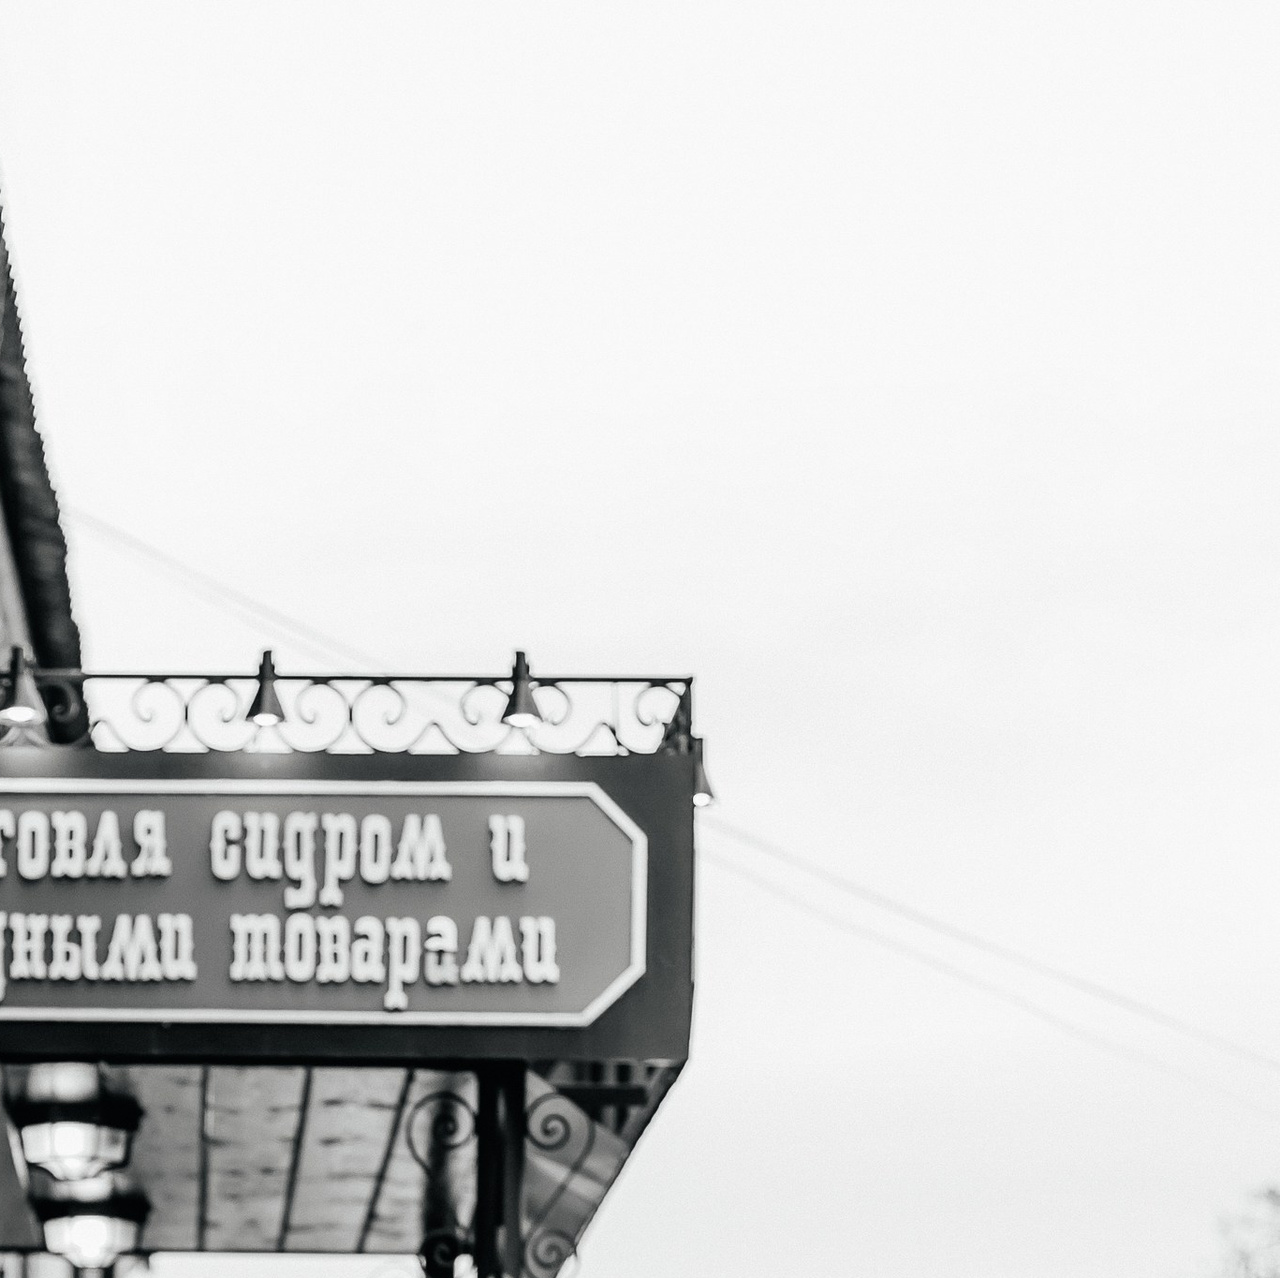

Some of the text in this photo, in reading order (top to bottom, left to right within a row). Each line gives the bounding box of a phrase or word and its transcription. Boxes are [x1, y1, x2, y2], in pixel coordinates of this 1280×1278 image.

[210, 809, 453, 908] сидром
[488, 809, 530, 882] и
[229, 912, 561, 1009] товарами
